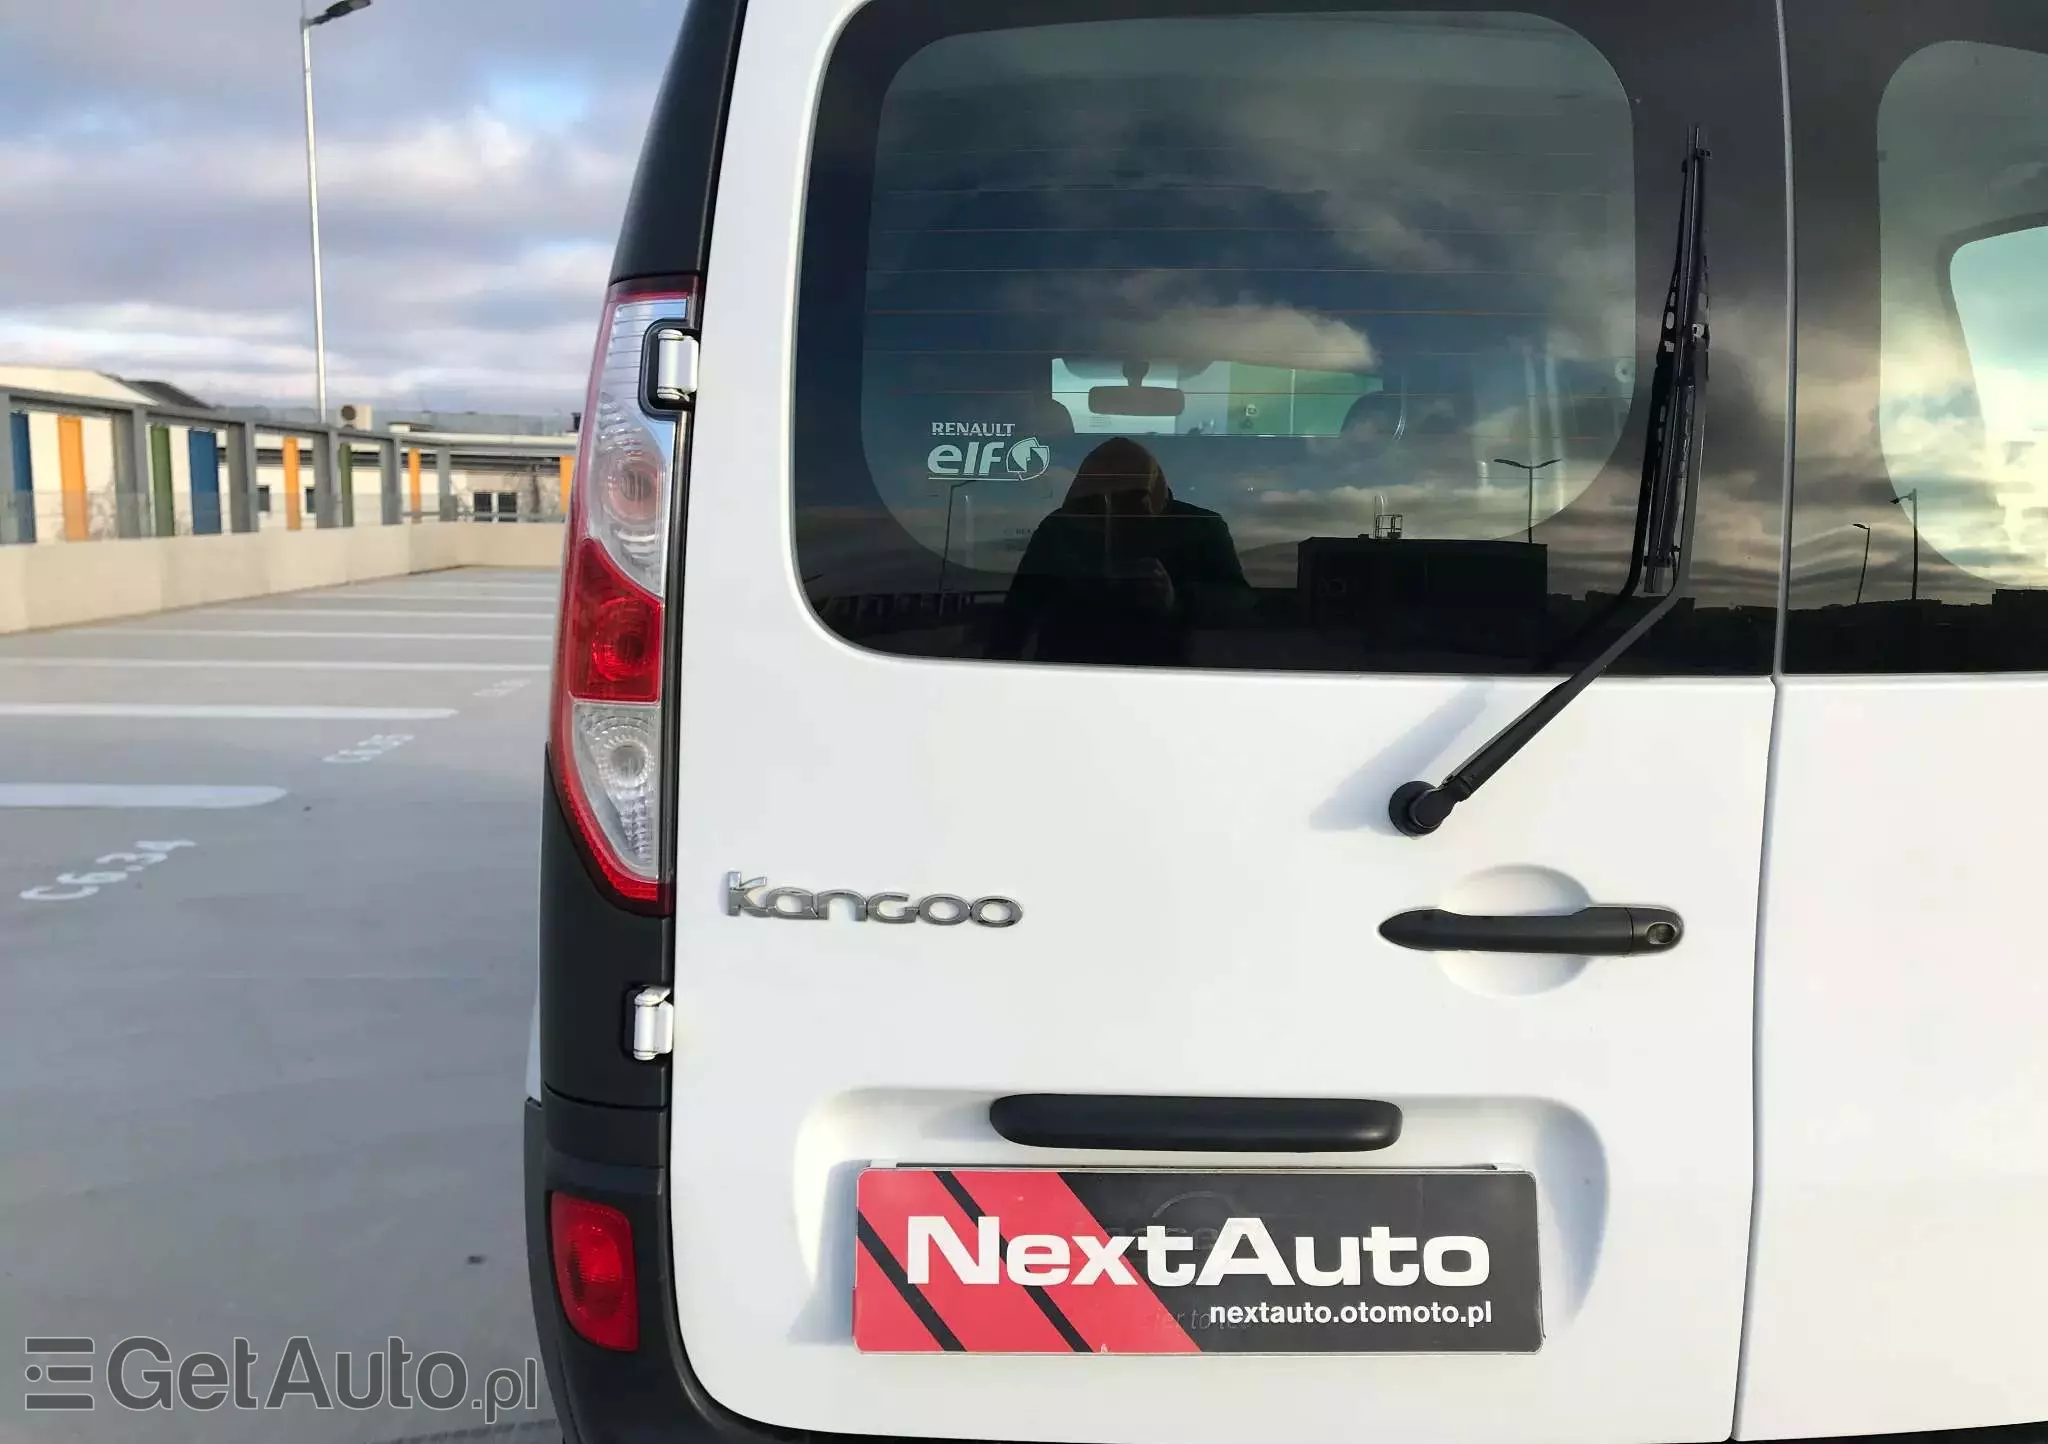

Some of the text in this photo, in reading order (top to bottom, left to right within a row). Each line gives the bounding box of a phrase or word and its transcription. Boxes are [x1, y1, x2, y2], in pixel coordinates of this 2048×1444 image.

[931, 422, 1016, 437] RENAULT
[927, 441, 1005, 476] elf
[907, 1216, 1491, 1287] NextAuto
[1209, 1300, 1493, 1327] nextauto.otomoto.pl
